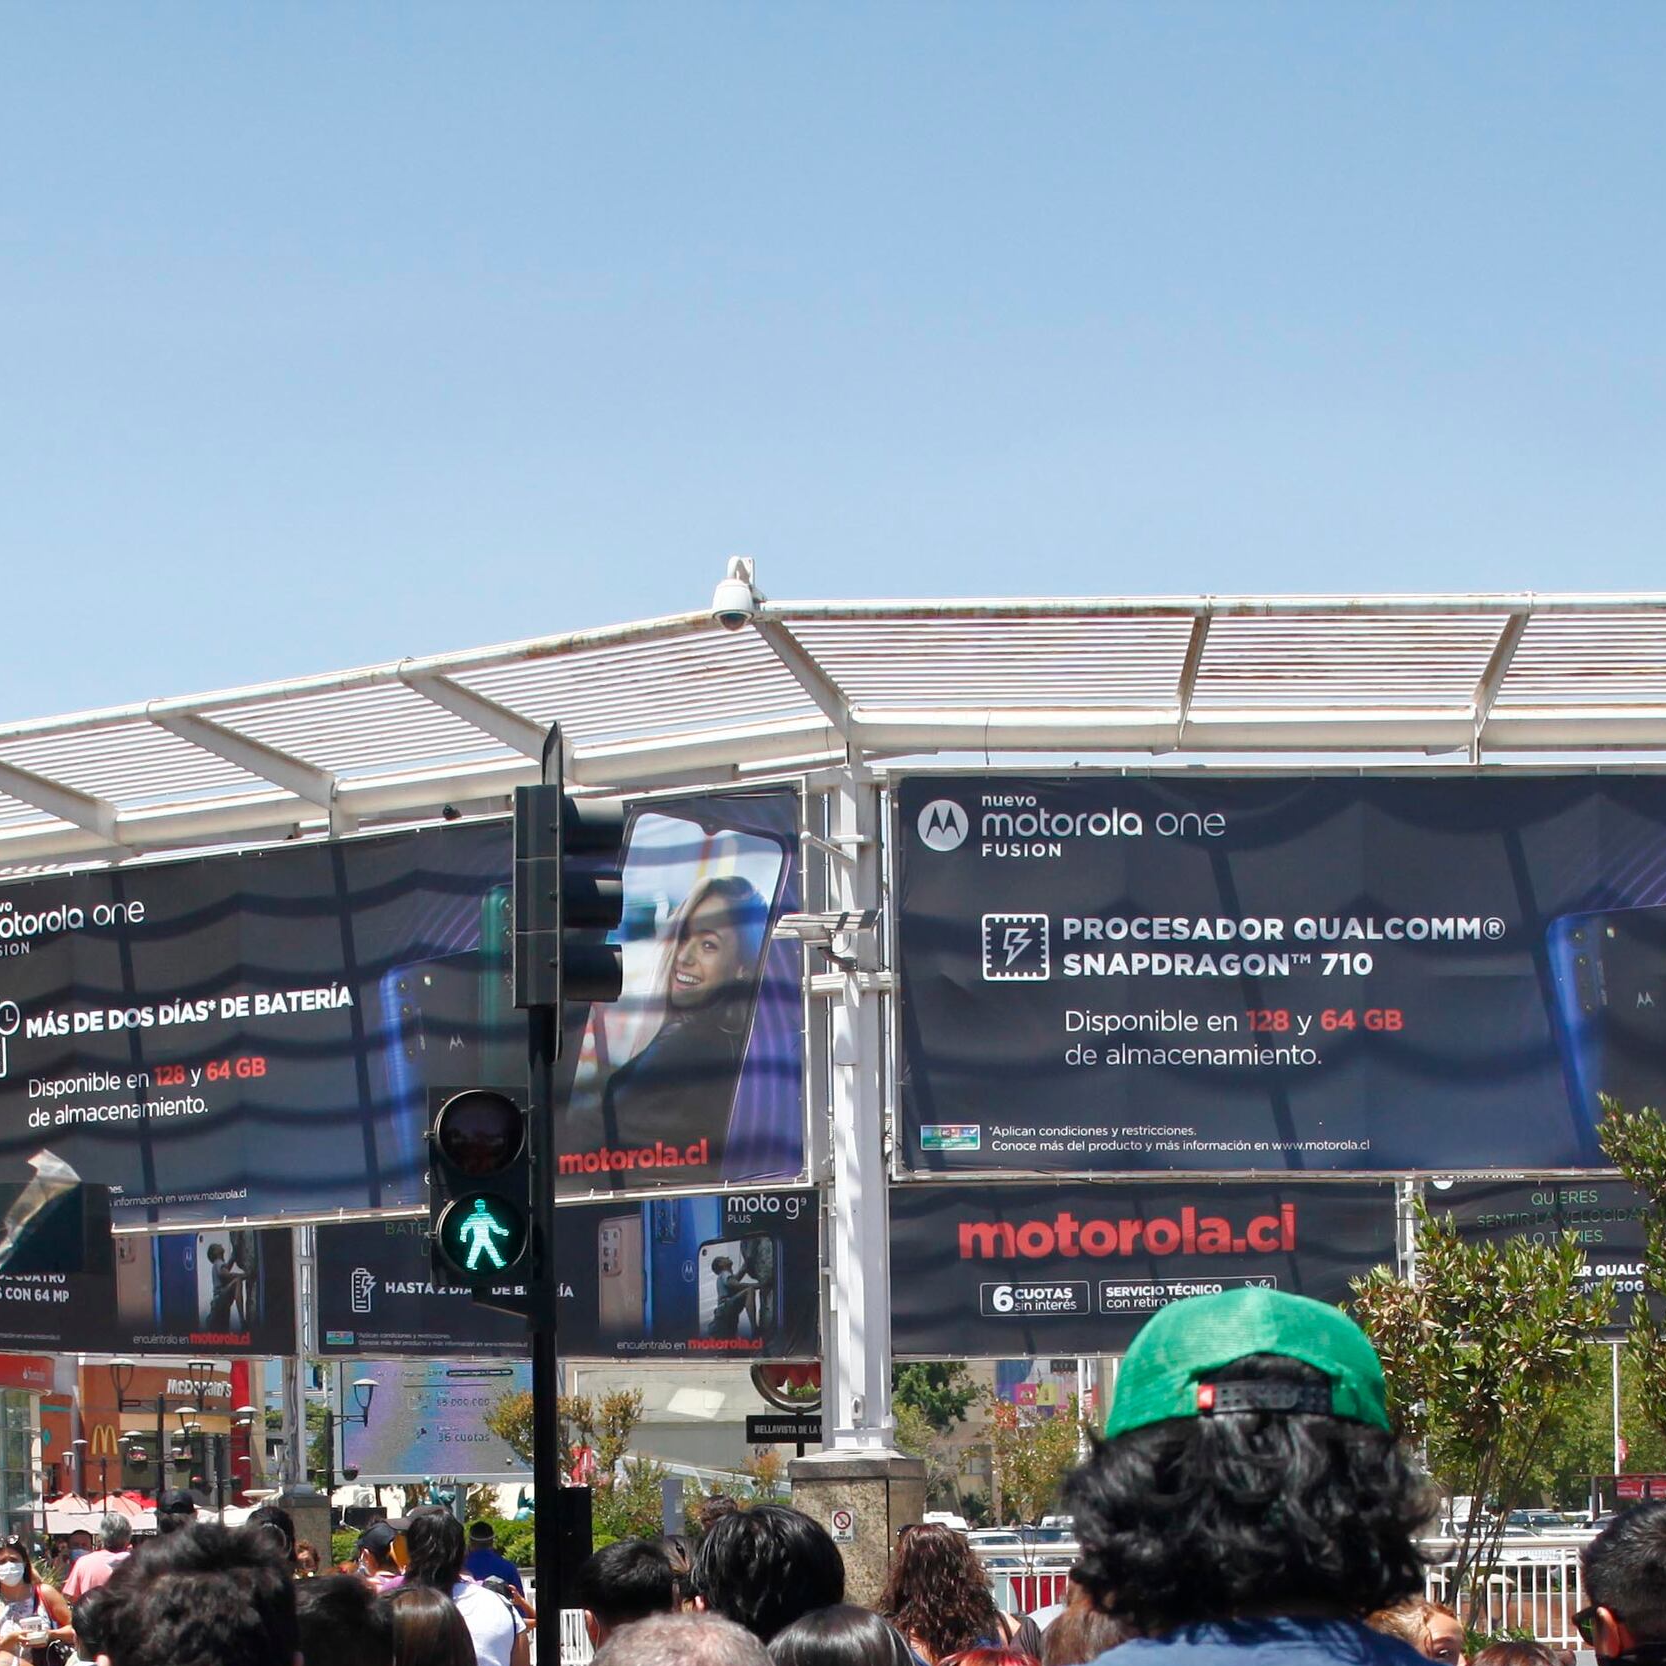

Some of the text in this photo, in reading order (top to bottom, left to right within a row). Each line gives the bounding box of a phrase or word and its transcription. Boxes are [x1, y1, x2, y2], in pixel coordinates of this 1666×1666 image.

[982, 795, 1037, 807] nuevo
[982, 807, 1226, 837] motorola one
[982, 843, 1062, 858] FUSION
[93, 901, 145, 926] one
[1063, 917, 1284, 941] PROCESADOR
[1321, 952, 1373, 977] 710
[26, 1010, 70, 1039] MÁS
[74, 1010, 104, 1033] DE
[108, 1007, 154, 1030] DOS
[220, 995, 250, 1020] DE
[255, 982, 354, 1016] BATERÍA
[1065, 1009, 1404, 1036] Disponible en 128 y 64 GB
[1065, 1043, 1323, 1065] de almacenamiento.
[28, 1056, 268, 1099] Disponible en 128 y 64 GB
[28, 1096, 209, 1128] de almacenamiento.
[1038, 1125, 1109, 1137] condiciones
[1111, 1128, 1119, 1138] y
[1122, 1125, 1197, 1137] restricciones.
[992, 1139, 1371, 1152] Conoce más del producto y más información en www.motorola.cl
[559, 1137, 709, 1175] motorola.cl
[728, 1193, 780, 1213] moto
[728, 1214, 752, 1224] PLUS
[958, 1203, 1296, 1260] motorola.cl
[5, 1286, 32, 1301] CON
[34, 1287, 50, 1302] 64
[52, 1289, 70, 1303] MP
[385, 1281, 434, 1295] HASTA
[1106, 1280, 1223, 1299] SERVICIO TÉCNICO
[992, 1286, 1073, 1313] 6 CUOTAS
[1015, 1298, 1078, 1312] sin interés
[1106, 1296, 1169, 1309] con retiro
[190, 1331, 252, 1346] motorola.cl
[617, 1336, 764, 1350] encuéntralo en motorola.cl
[455, 1432, 491, 1442] cuotas
[754, 1425, 819, 1435] BELLAVISTA DE LA
